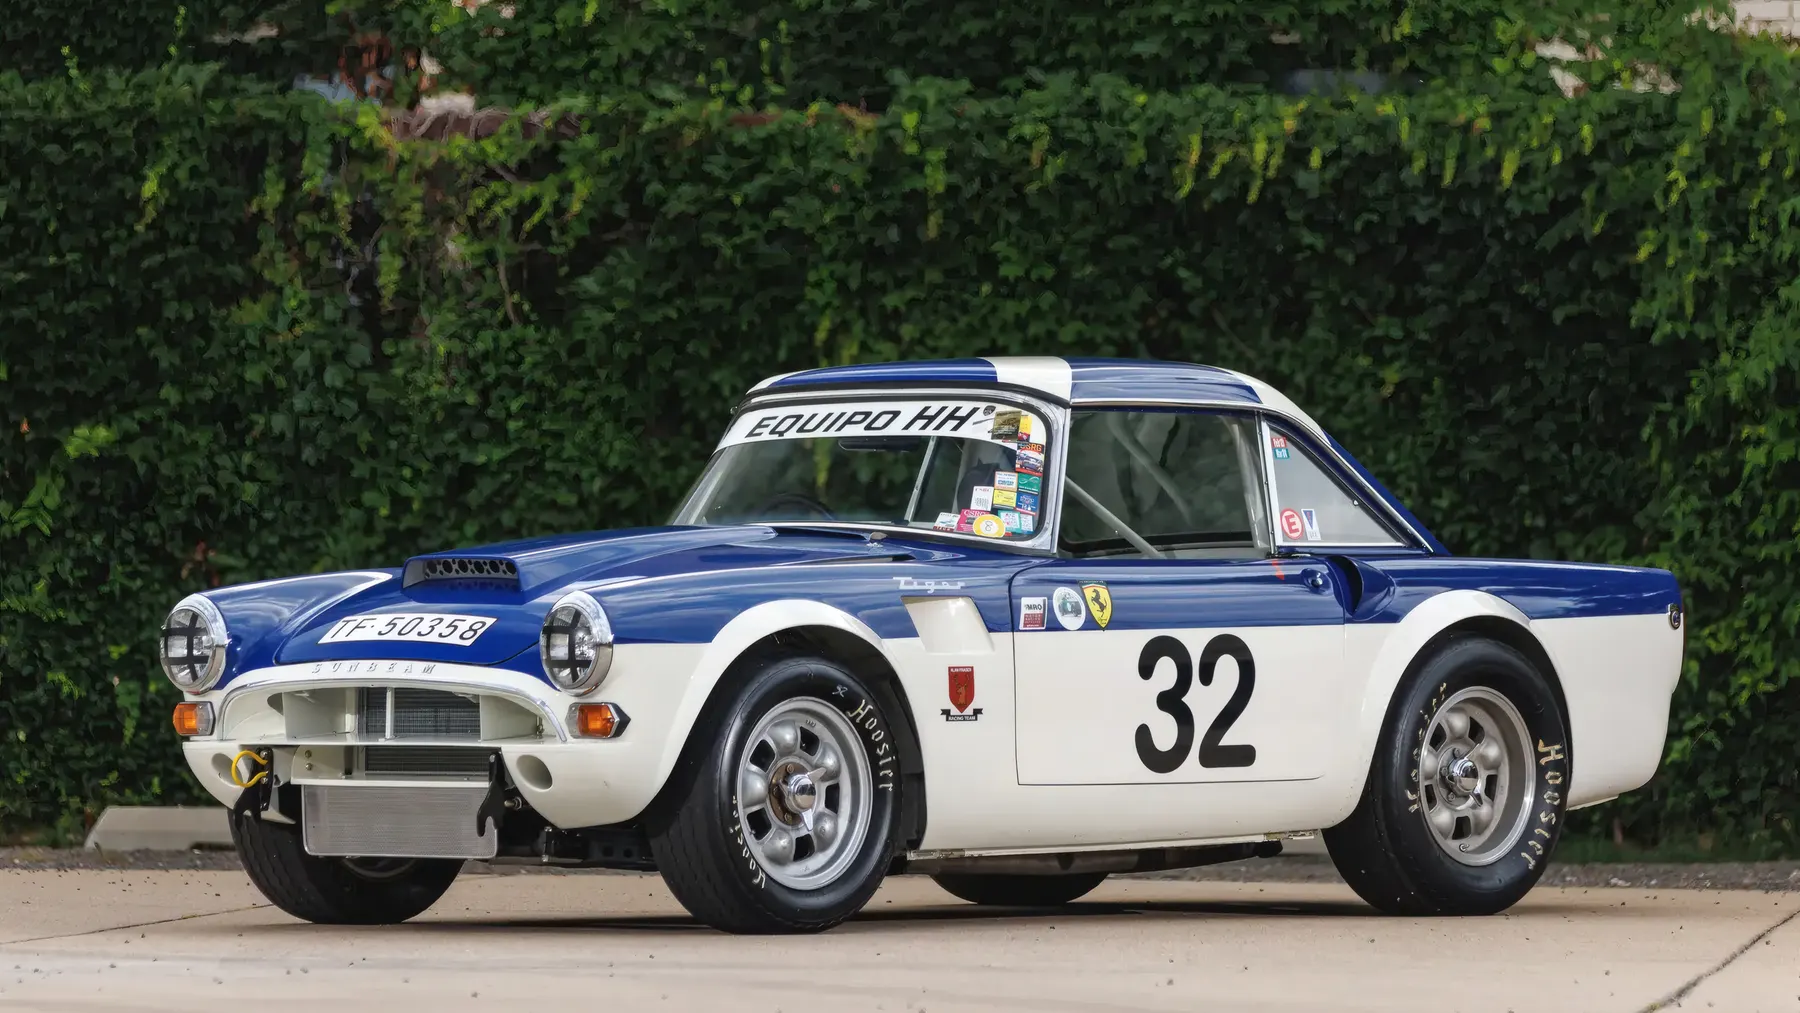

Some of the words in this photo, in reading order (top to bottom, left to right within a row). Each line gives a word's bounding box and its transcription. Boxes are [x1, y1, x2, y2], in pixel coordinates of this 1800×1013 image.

[744, 410, 902, 439] EQUIPO
[901, 405, 980, 432] HH
[1285, 514, 1300, 534] E
[892, 576, 966, 594] Tiger
[311, 662, 437, 675] SUNBEAM
[1134, 633, 1256, 774] 32
[846, 699, 896, 792] Hoosier
[1521, 738, 1564, 870] Hoosier
